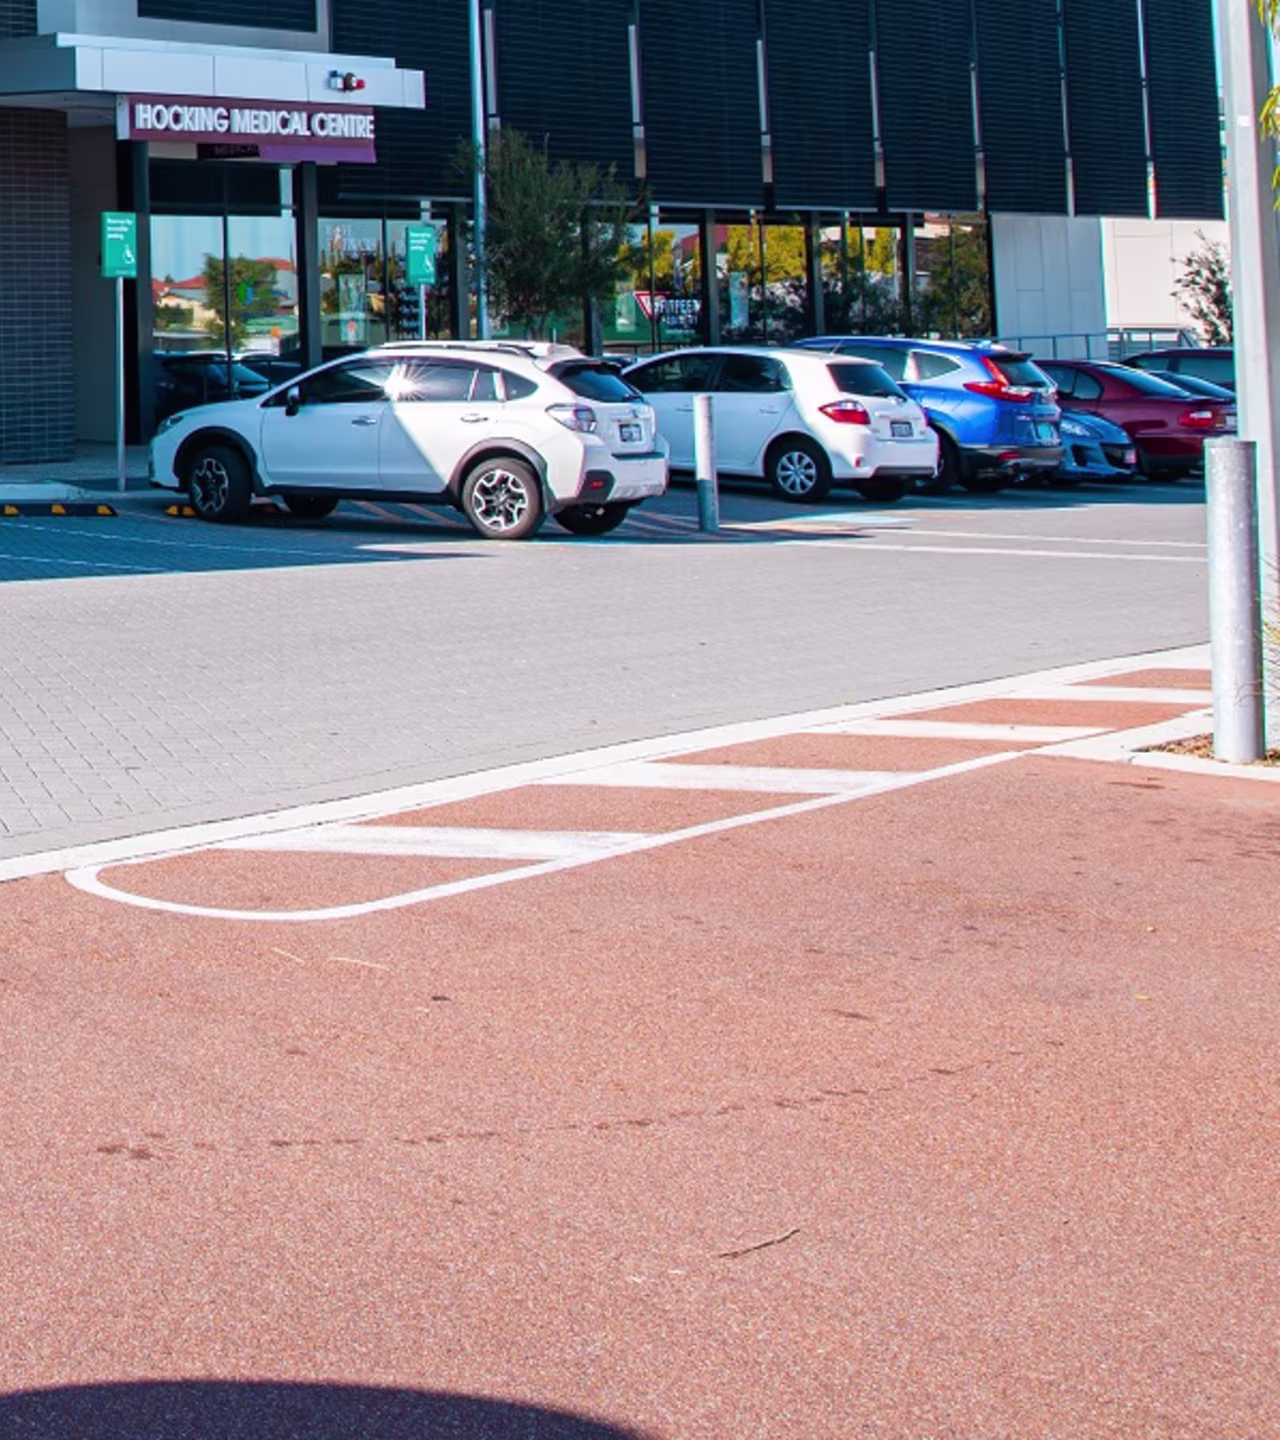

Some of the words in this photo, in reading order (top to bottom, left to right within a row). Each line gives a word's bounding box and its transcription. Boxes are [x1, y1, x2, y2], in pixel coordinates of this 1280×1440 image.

[134, 103, 229, 133] HOCKING
[230, 108, 311, 137] MEDICAL
[311, 112, 376, 139] CENTRE
